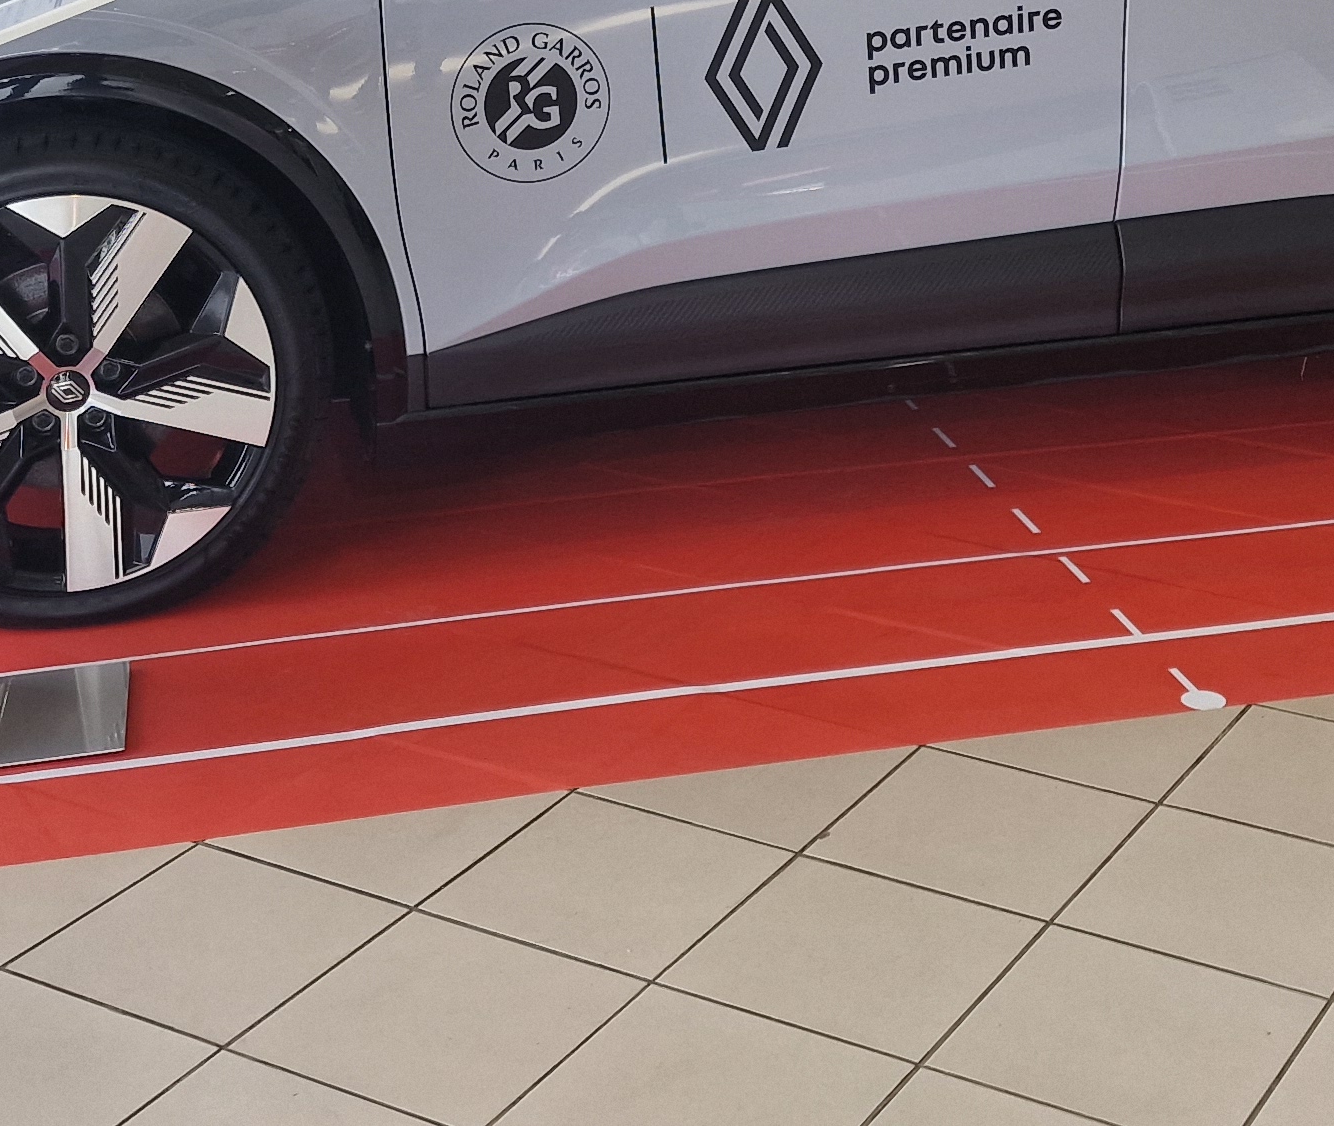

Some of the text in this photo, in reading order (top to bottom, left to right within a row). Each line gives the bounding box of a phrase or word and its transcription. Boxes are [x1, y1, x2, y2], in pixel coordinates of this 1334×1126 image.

[866, 5, 1062, 60] partenaire
[460, 32, 602, 130] ROLAND GARROS
[868, 46, 1031, 94] premium
[487, 137, 583, 171] PARIS
